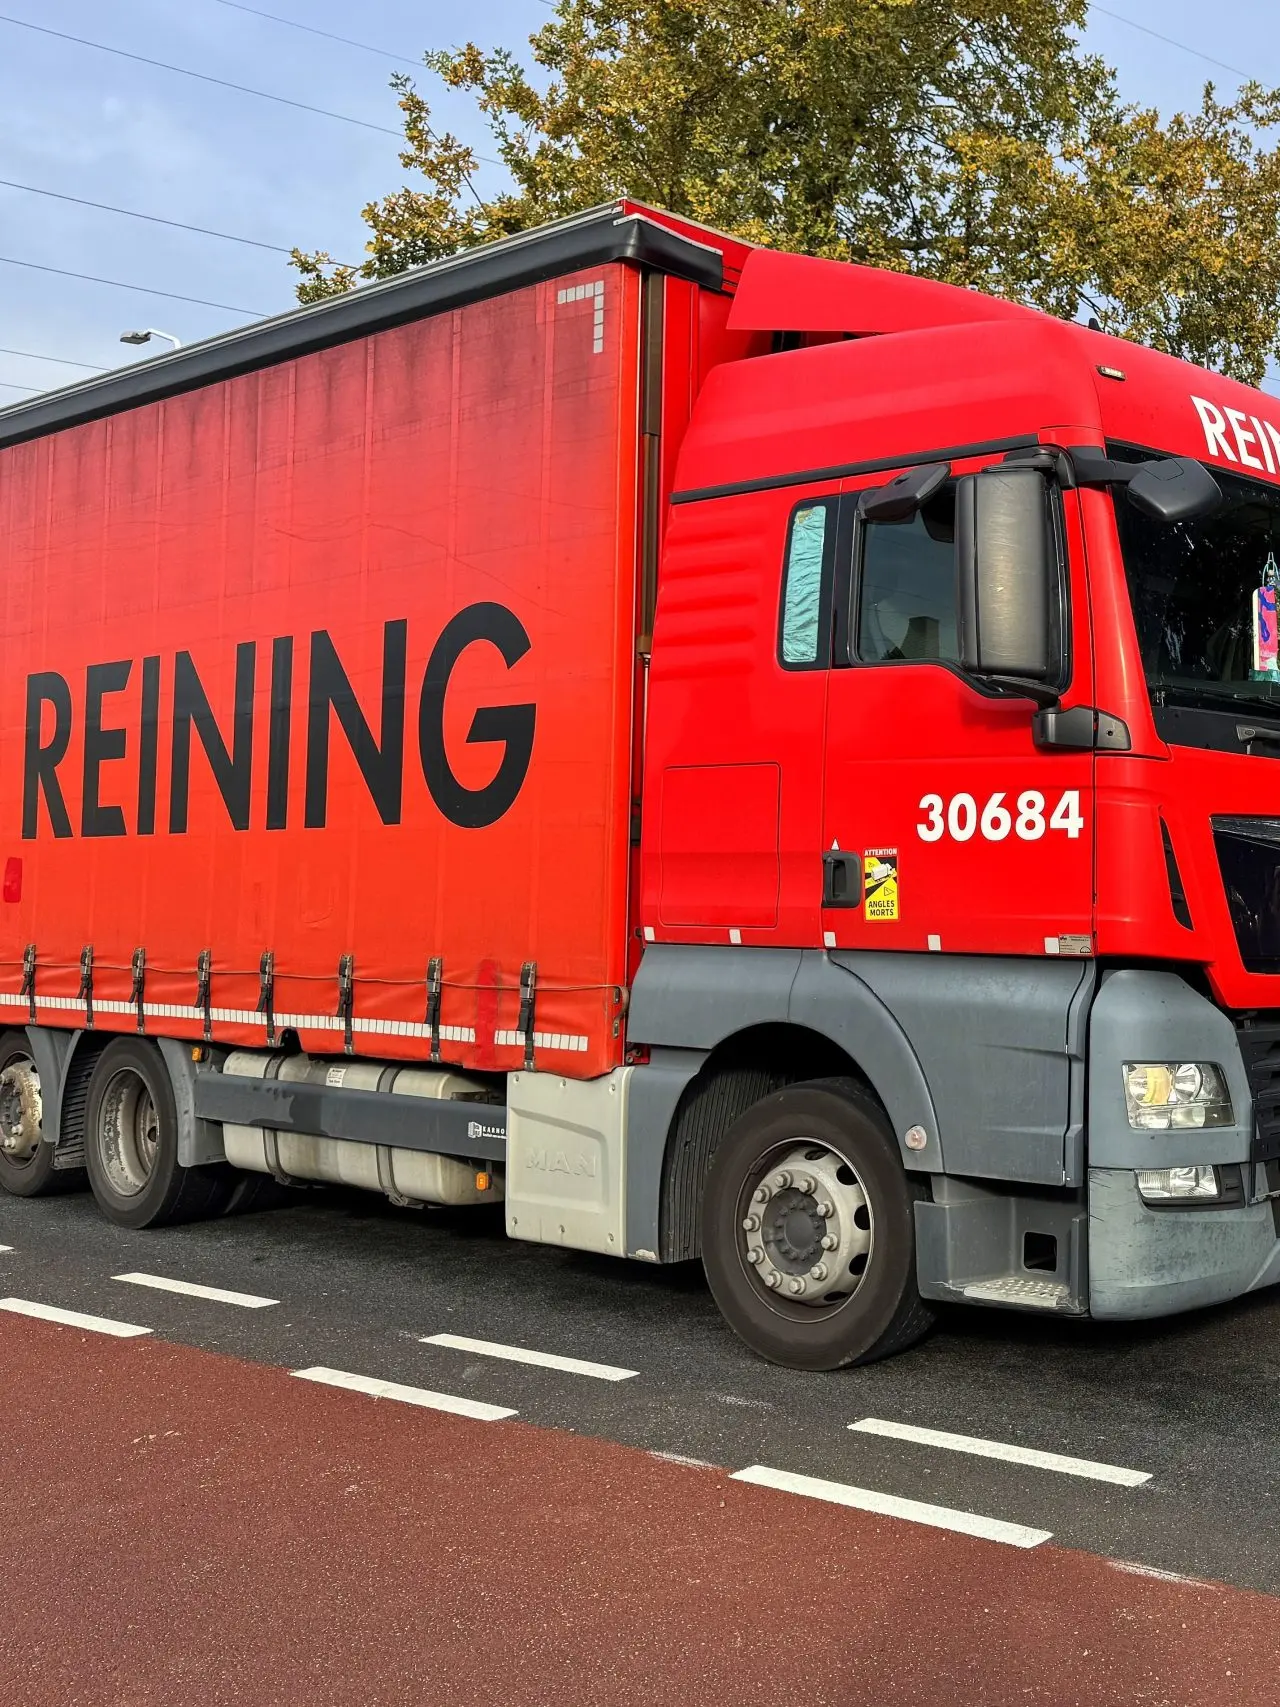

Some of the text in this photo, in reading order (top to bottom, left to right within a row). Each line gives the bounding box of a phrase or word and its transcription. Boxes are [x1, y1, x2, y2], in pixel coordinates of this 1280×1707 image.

[21, 601, 537, 840] REINING
[916, 789, 1084, 842] 30684
[864, 848, 898, 856] ATTENTION
[868, 900, 895, 908] ANGLES
[870, 908, 894, 916] MORTS
[525, 1147, 597, 1178] MAN
